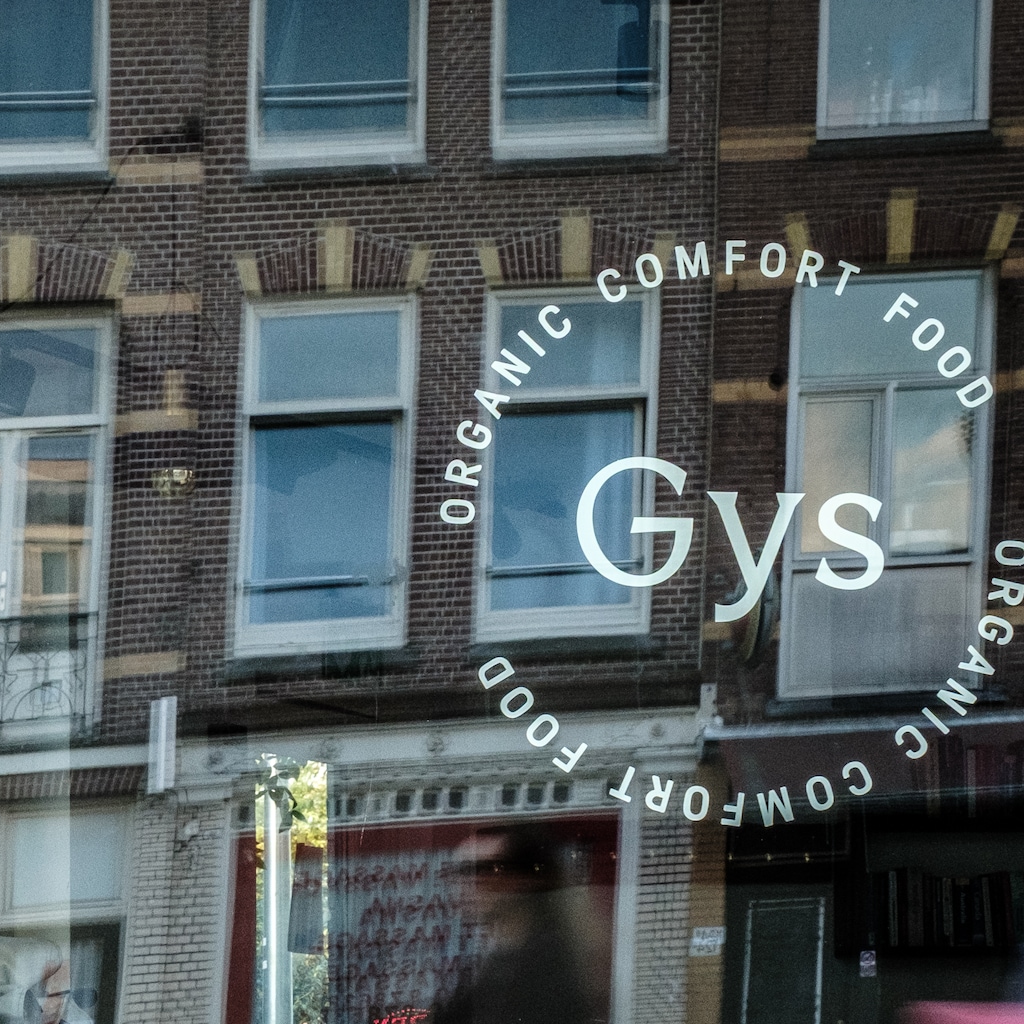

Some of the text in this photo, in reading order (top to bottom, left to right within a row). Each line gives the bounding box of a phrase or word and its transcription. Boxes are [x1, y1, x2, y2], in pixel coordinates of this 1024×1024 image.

[439, 239, 994, 526] ORGANIC COMFORT FOOD
[576, 456, 885, 623] Gys
[478, 540, 1024, 828] ORGANIC COMFORT FOOD
